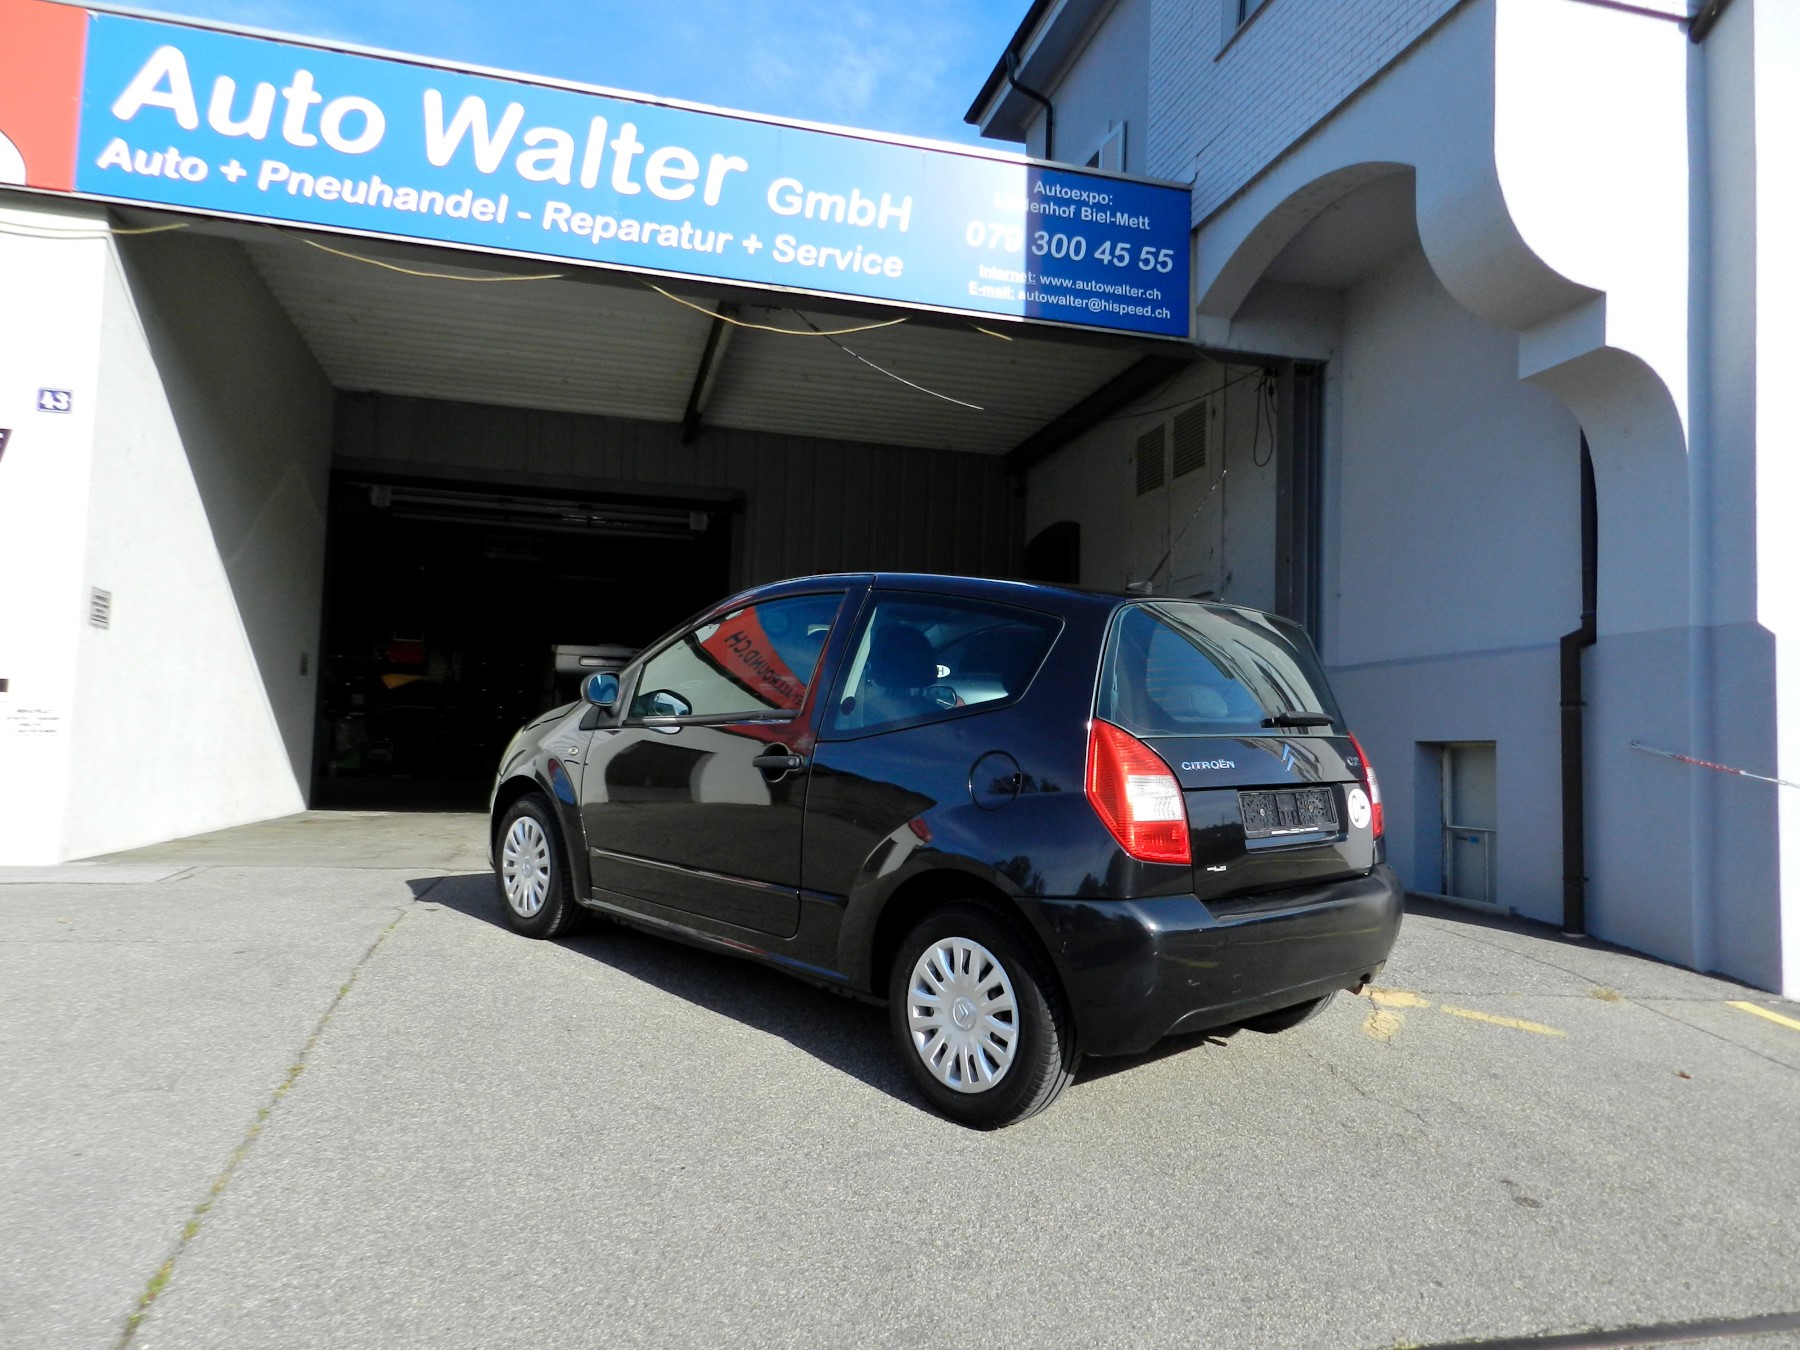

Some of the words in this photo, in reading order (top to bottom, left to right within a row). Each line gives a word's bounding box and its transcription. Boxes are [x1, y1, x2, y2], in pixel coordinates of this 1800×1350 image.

[111, 45, 386, 154] Auto
[423, 88, 749, 207] Walter
[766, 178, 913, 233] GmbH
[97, 137, 208, 182] Auto
[219, 159, 247, 182] +
[257, 160, 508, 224] Pneuhandel
[541, 200, 734, 255] Reparatur
[742, 235, 763, 255] +
[773, 234, 905, 279] Service
[1034, 181, 1113, 206] Autoexpo:
[1081, 206, 1150, 230] Biel-Mett
[966, 219, 1023, 253] 079
[1031, 231, 1087, 261] 300
[1094, 240, 1131, 267] 45
[1138, 246, 1174, 274] 55
[968, 281, 1015, 301] E-mail:
[1018, 290, 1170, 320] autowalter@hispeed.ch
[979, 264, 1037, 285] Internet:
[1040, 274, 1161, 300] www.autowalter.ch
[1181, 759, 1236, 771] CITROËN
